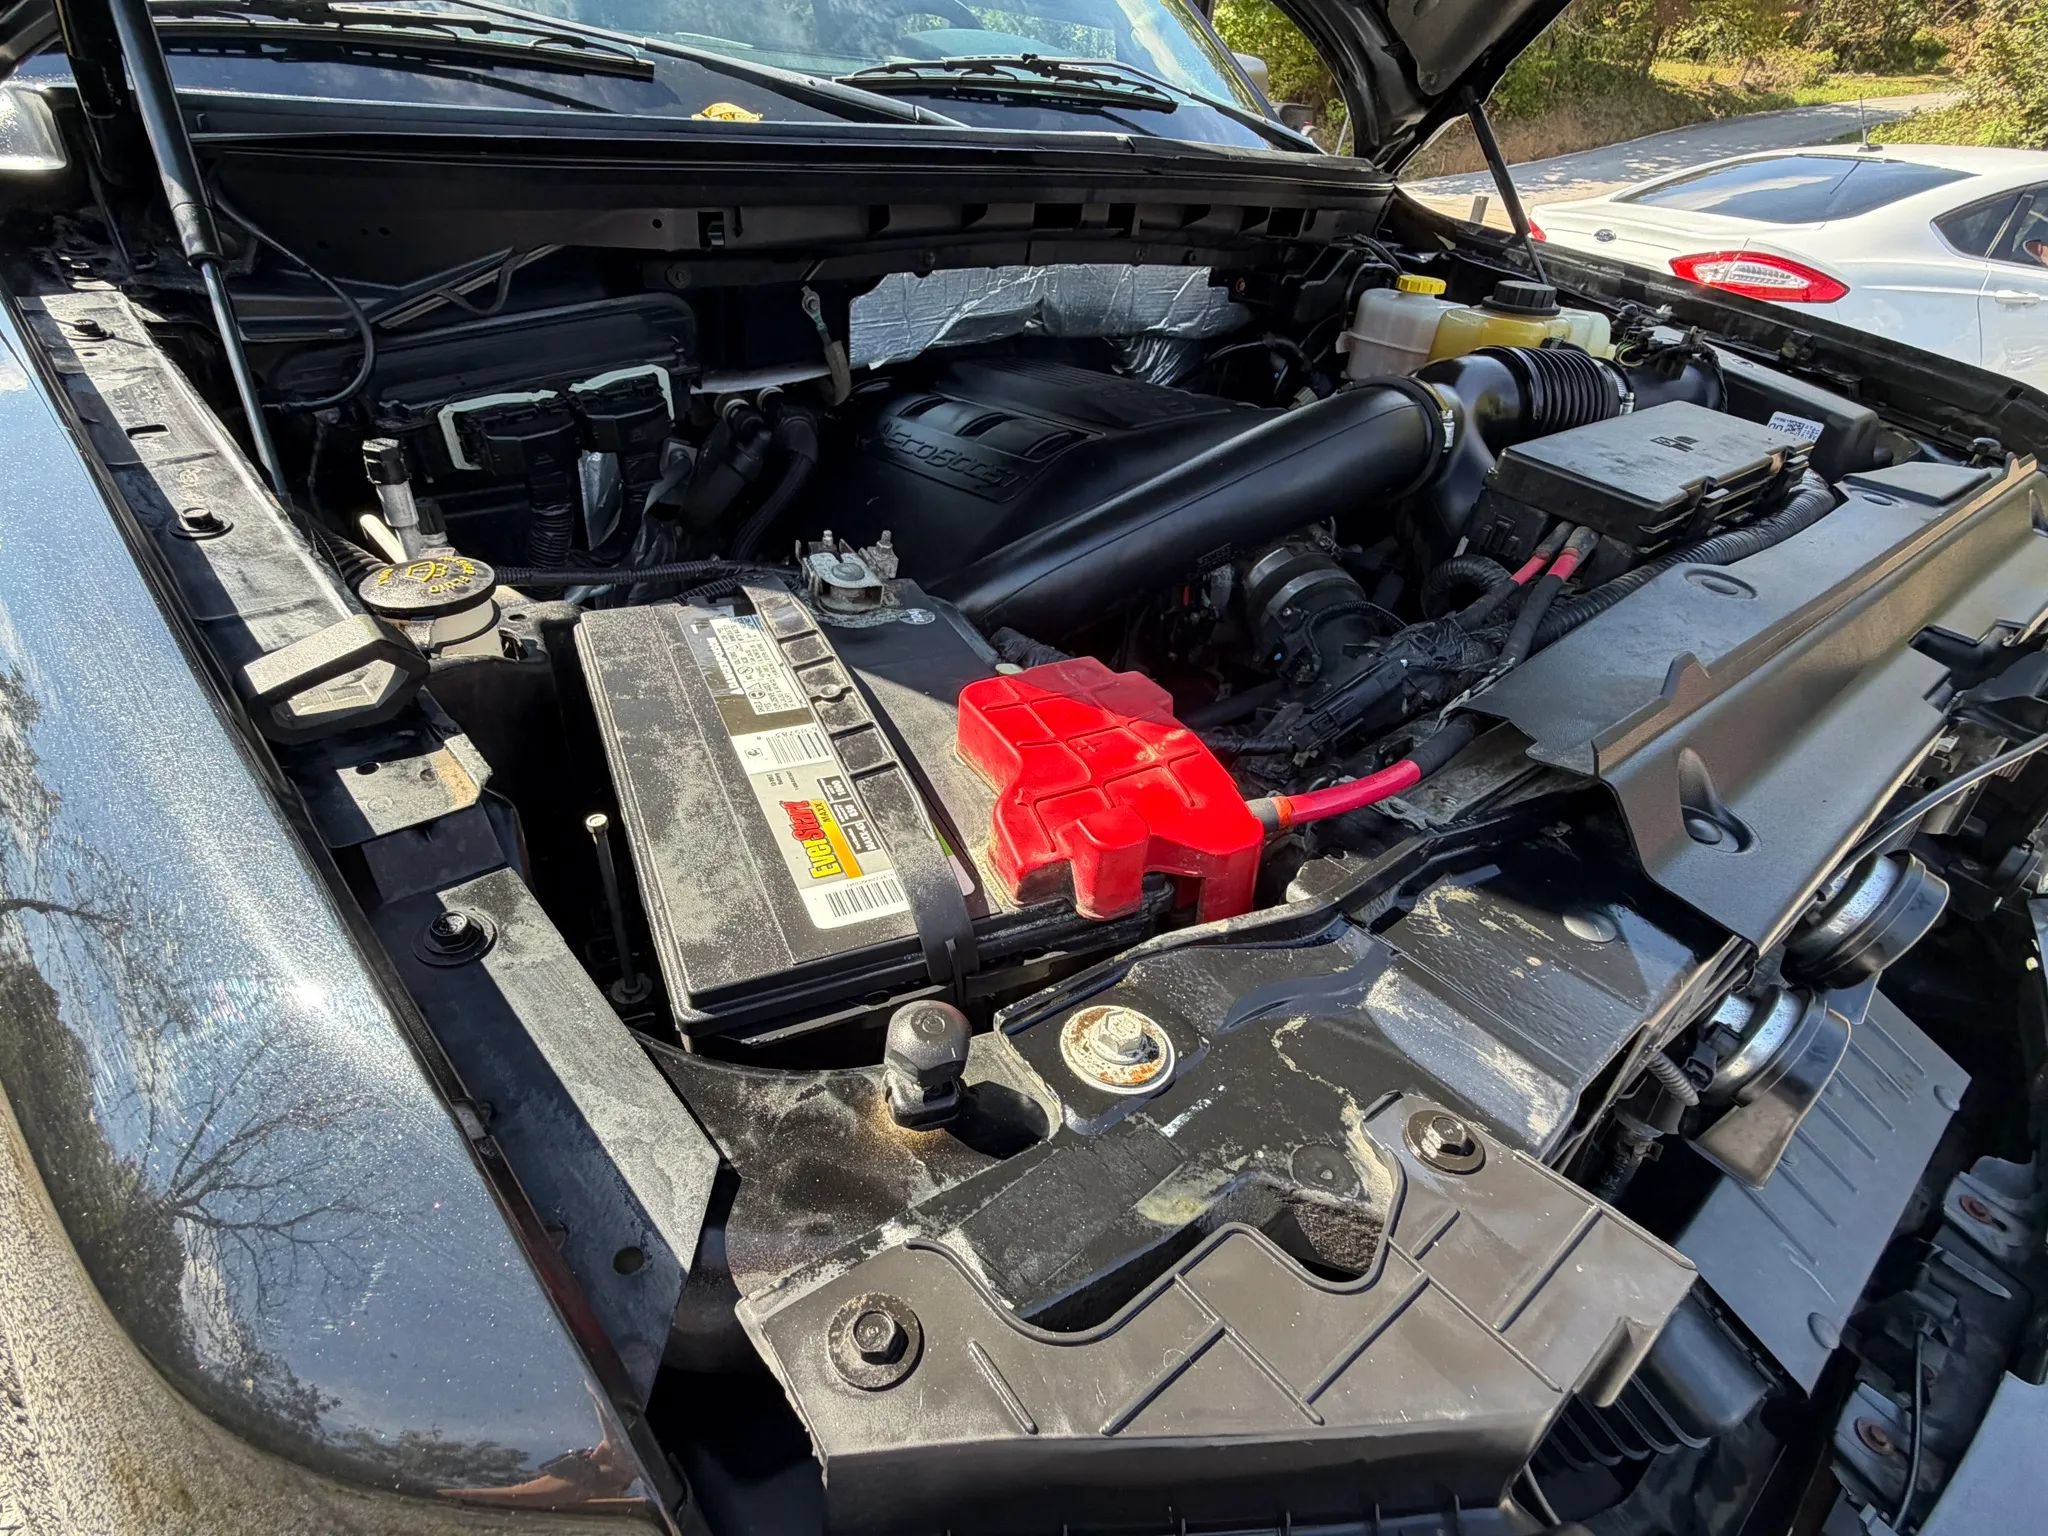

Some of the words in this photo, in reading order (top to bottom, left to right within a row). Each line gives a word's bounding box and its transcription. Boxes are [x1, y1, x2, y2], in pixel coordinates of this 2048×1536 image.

[429, 575, 471, 593] FLUID
[831, 780, 847, 796] 1000
[814, 802, 832, 823] MAXX
[780, 800, 842, 879] EverStart
